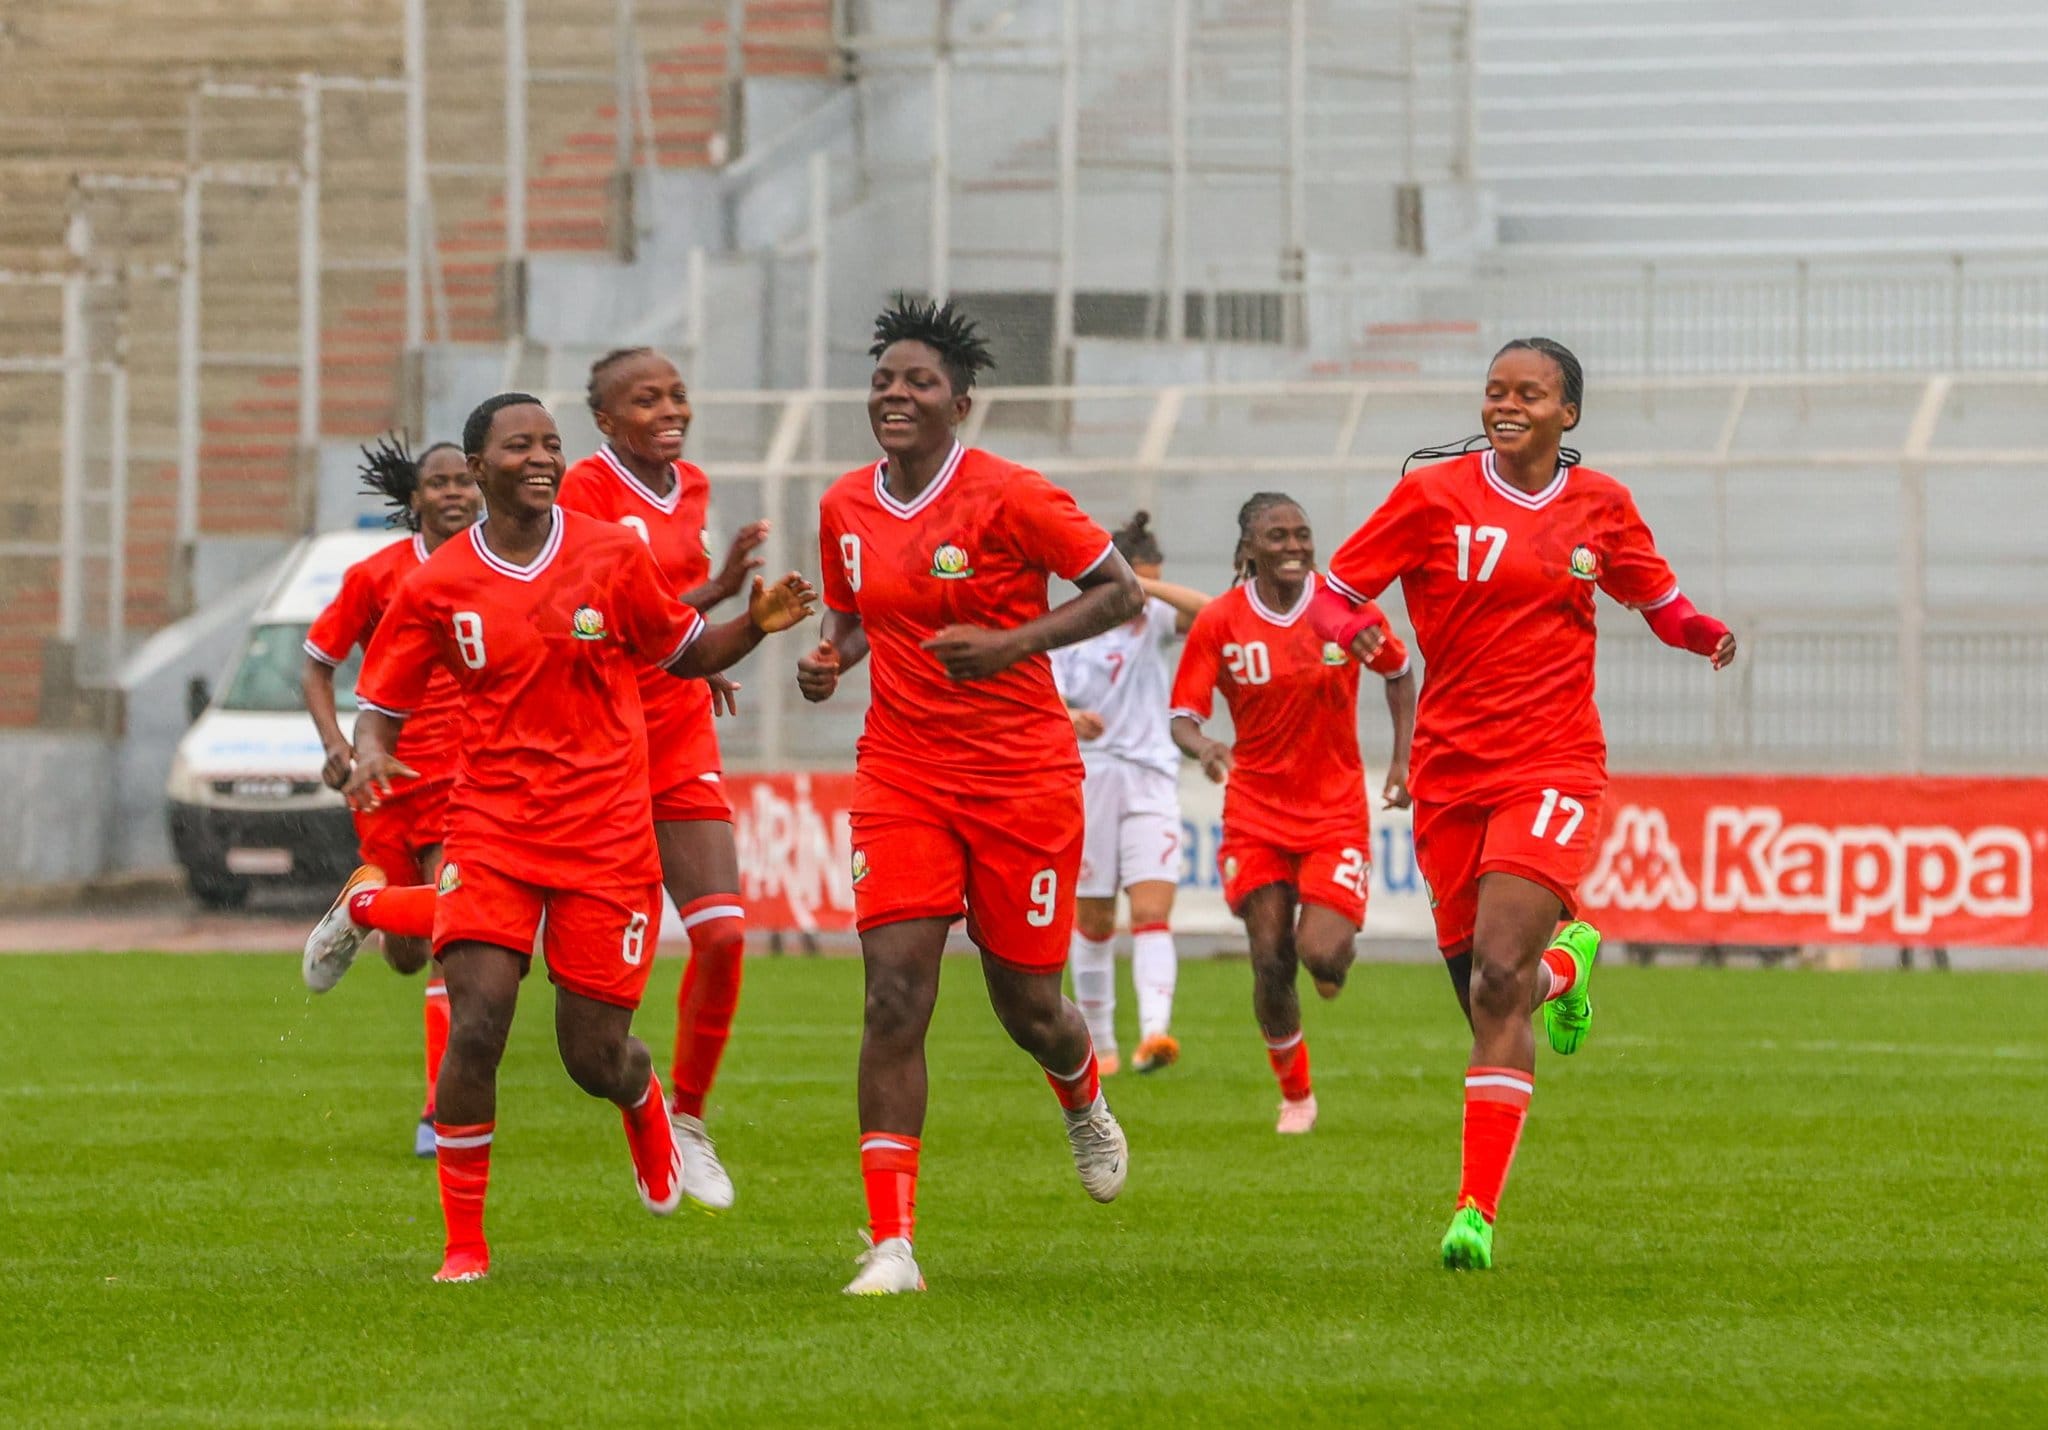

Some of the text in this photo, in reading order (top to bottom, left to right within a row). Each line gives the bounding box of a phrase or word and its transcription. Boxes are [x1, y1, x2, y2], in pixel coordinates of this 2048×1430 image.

[840, 532, 861, 593] 9
[1454, 524, 1507, 582] 17
[453, 611, 486, 669] 8
[1105, 652, 1124, 685] 7
[1222, 640, 1271, 685] 20
[1531, 788, 1584, 846] 17
[1160, 830, 1178, 867] 7
[1704, 806, 2033, 933] Kappa
[1027, 869, 1057, 927] 9
[623, 911, 649, 965] 8
